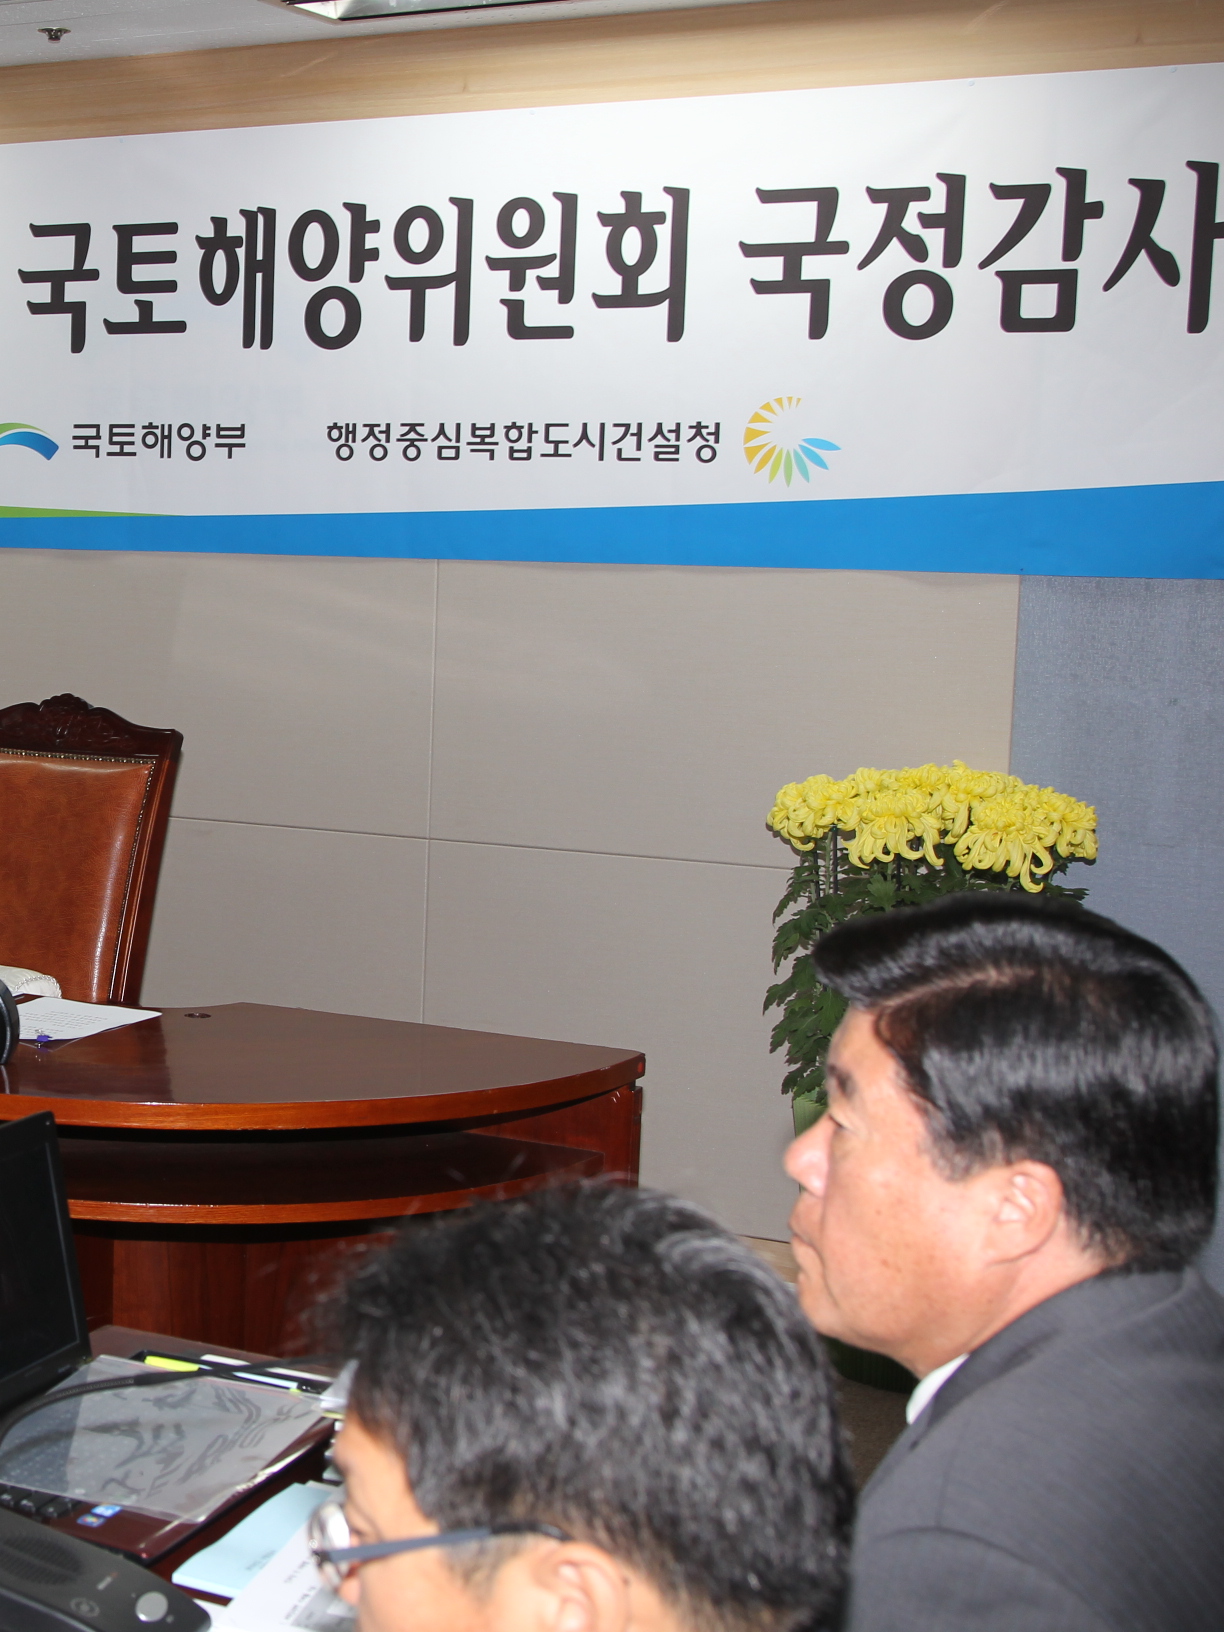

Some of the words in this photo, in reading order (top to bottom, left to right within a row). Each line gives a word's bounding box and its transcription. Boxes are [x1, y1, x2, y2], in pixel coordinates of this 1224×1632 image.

[18, 187, 689, 353] 국토해양위원회
[740, 161, 1224, 340] 국정감사
[72, 422, 246, 461] 국토해양부
[327, 421, 721, 463] 행정중심복합도시건설청
